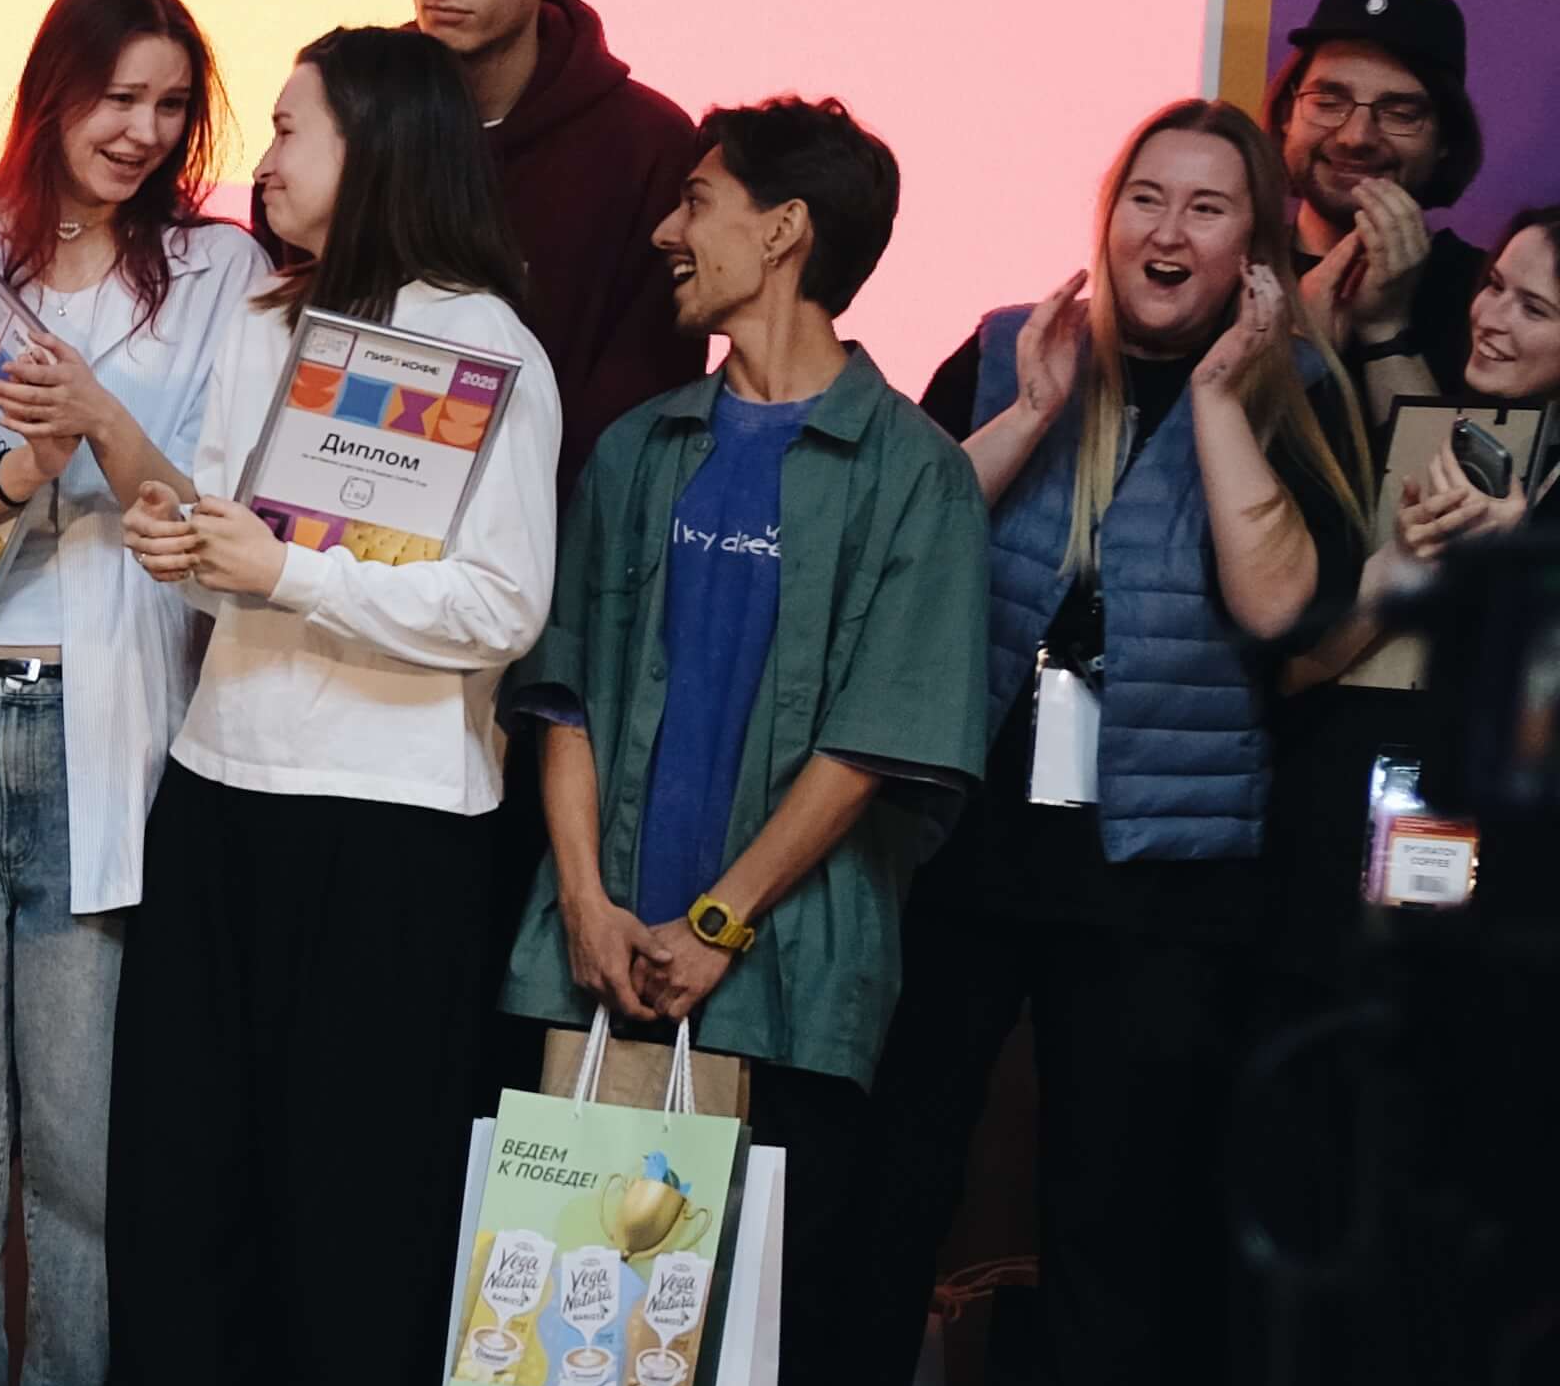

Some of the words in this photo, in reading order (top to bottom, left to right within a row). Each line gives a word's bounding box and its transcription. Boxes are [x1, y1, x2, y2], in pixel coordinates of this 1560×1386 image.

[319, 432, 421, 472] Диплом
[502, 1139, 568, 1163] ВЕДЕМ
[497, 1161, 512, 1176] К
[516, 1163, 597, 1190] ПОБЕДЕ!
[499, 1247, 539, 1273] Vega
[571, 1268, 609, 1293] Vega
[659, 1272, 696, 1294] Vega
